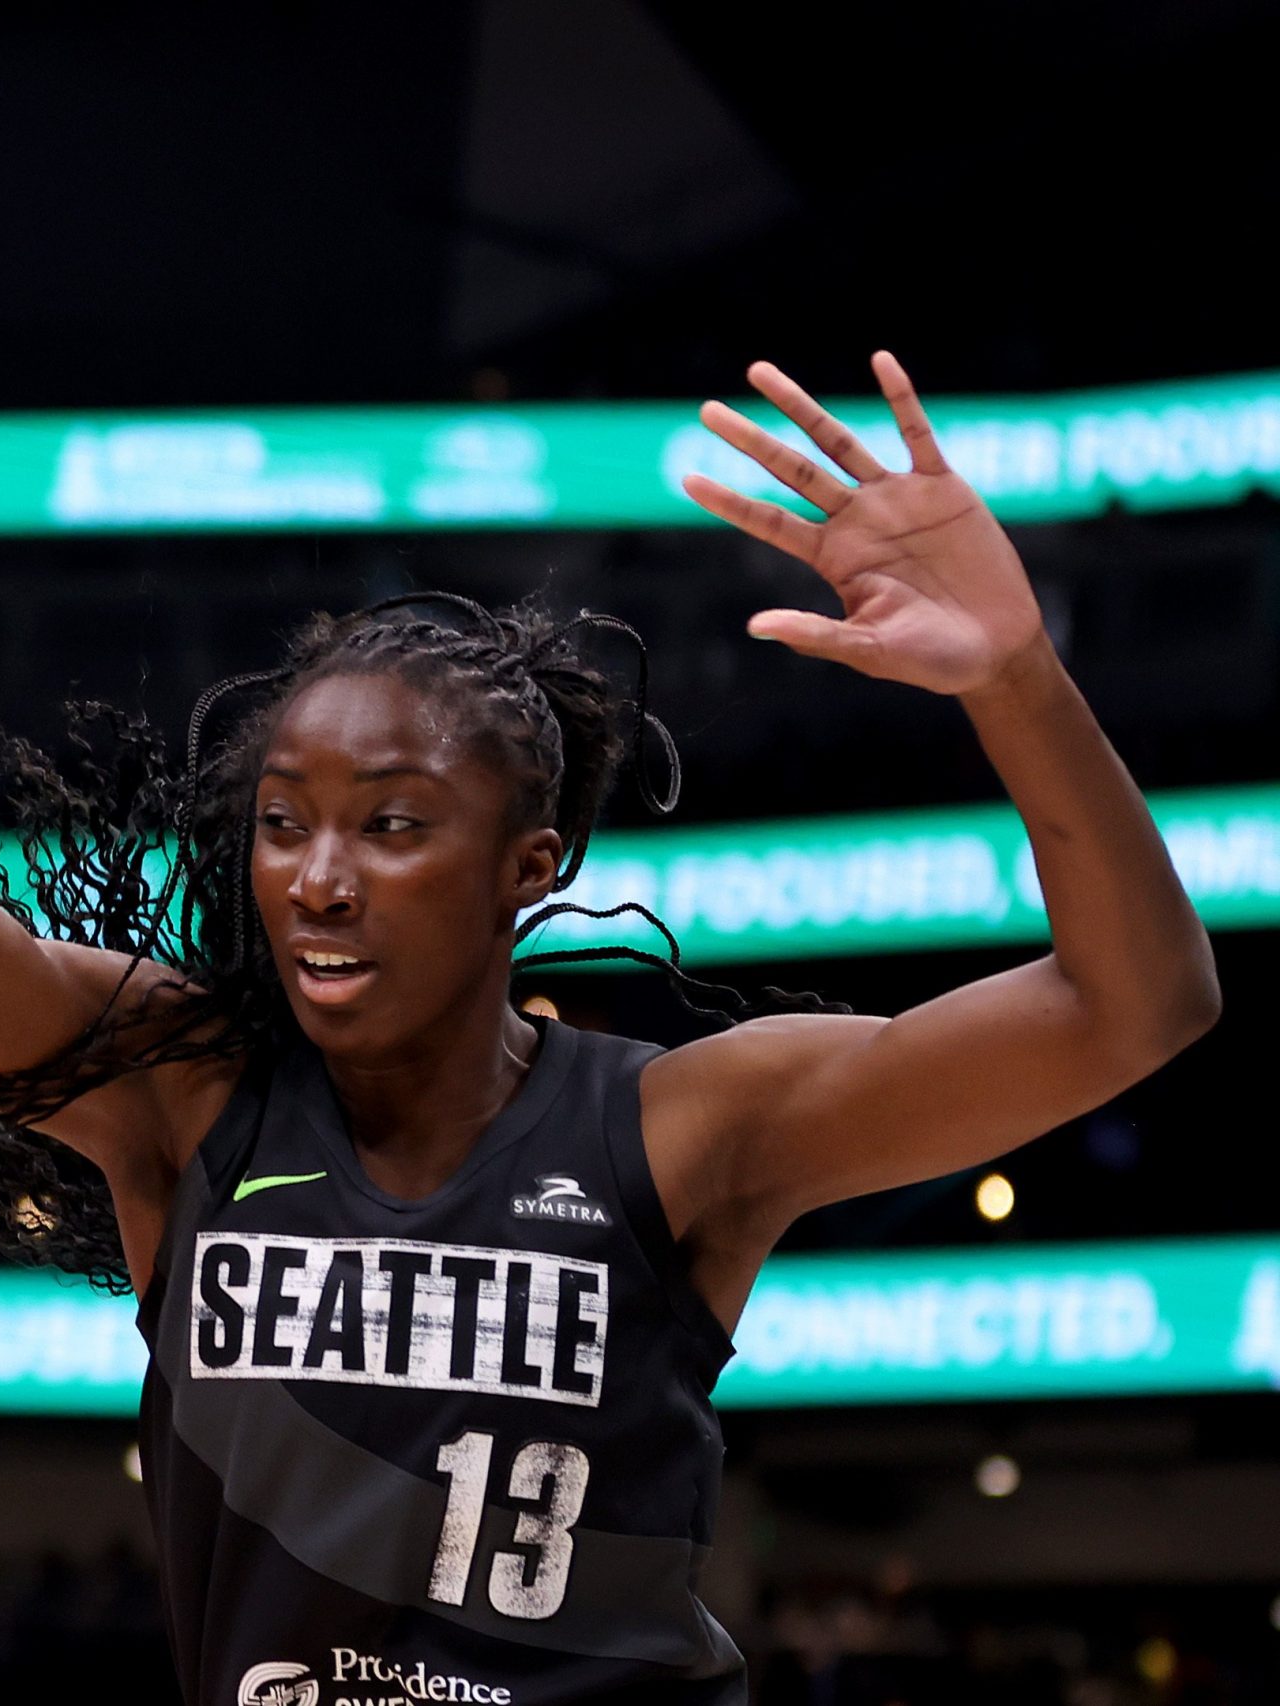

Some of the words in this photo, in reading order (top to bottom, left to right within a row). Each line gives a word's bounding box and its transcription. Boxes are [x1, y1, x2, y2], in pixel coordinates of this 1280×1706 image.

[513, 1199, 606, 1223] SYMETRA
[197, 1242, 600, 1397] SEATTLE
[426, 1429, 590, 1620] 13
